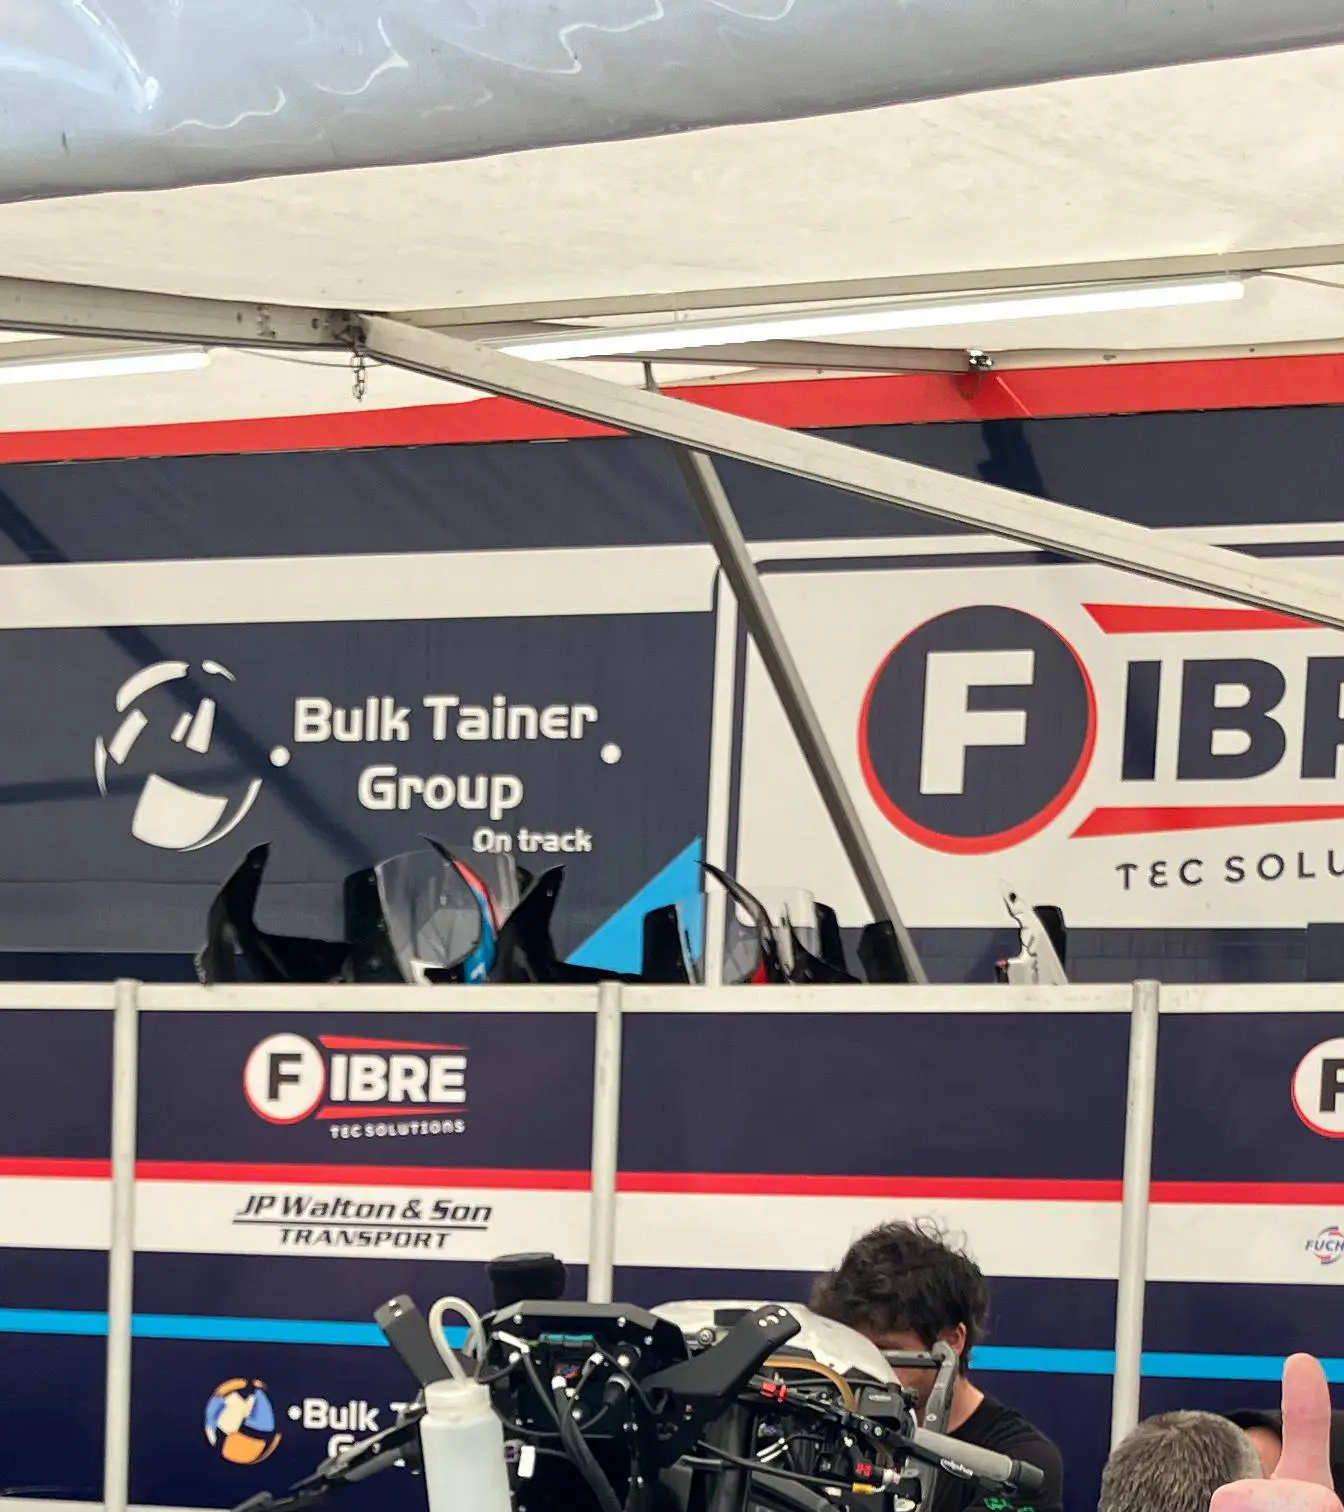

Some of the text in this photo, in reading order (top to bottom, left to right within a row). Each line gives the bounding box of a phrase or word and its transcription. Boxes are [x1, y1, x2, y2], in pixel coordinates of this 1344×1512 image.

[294, 695, 598, 743] Bulk Tainer
[358, 766, 524, 820] Group
[473, 828, 593, 855] On track
[267, 1051, 467, 1104] FIBRE
[237, 1195, 494, 1223] JP Walton & Son
[279, 1228, 452, 1249] TRANSPORT
[303, 1398, 381, 1432] Bulk
